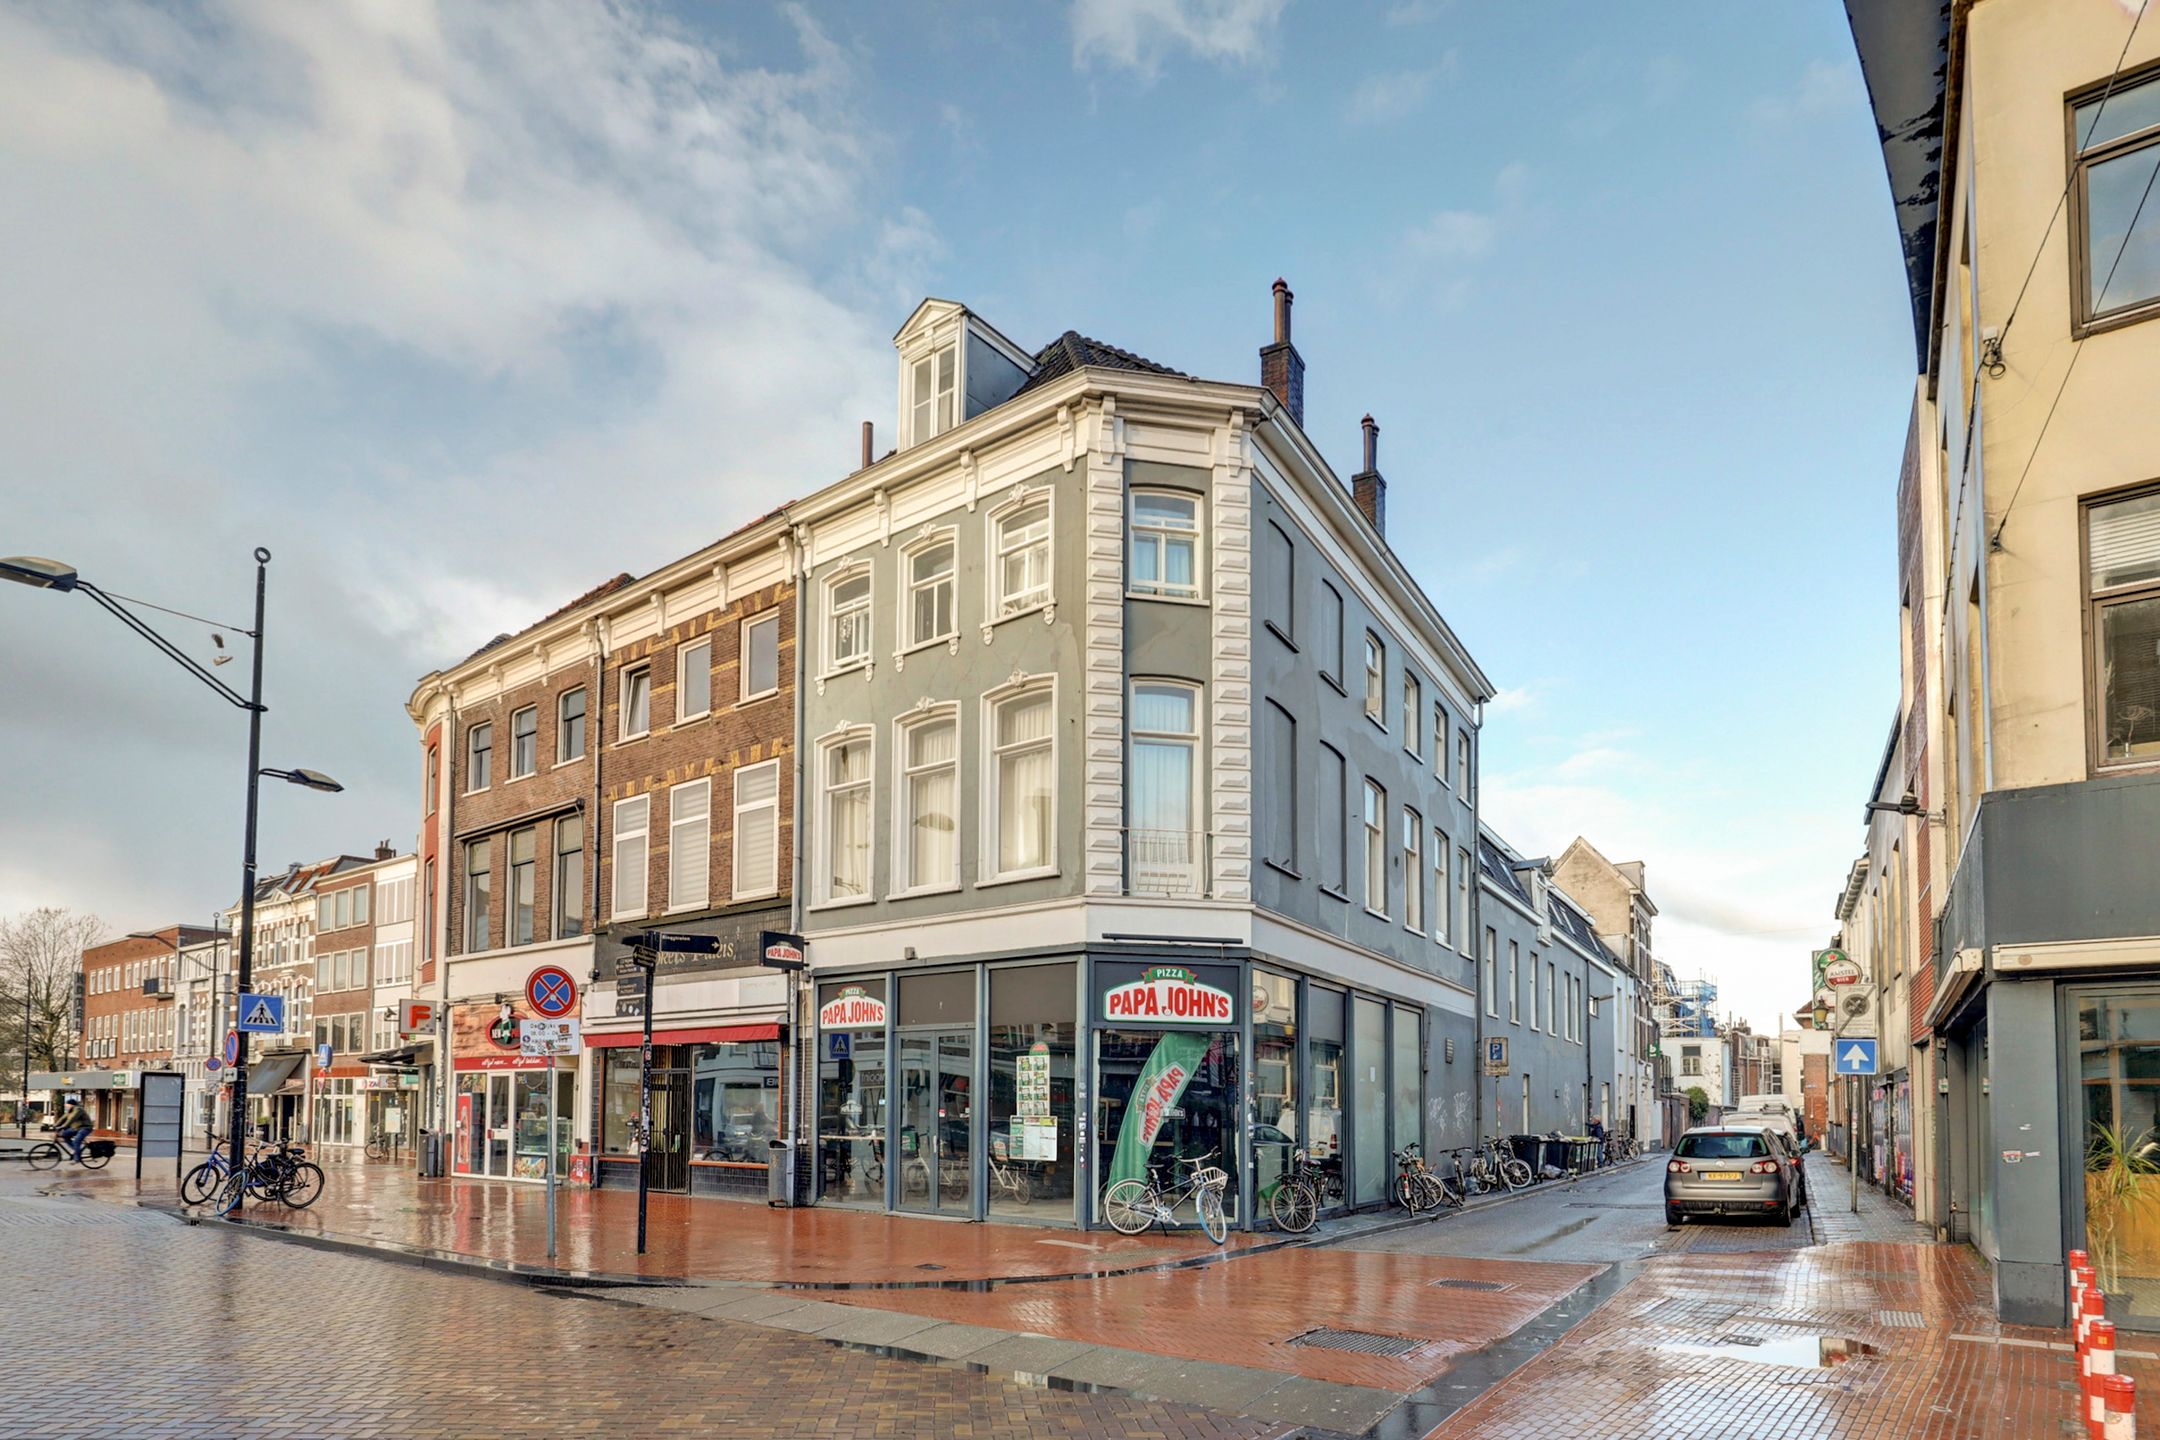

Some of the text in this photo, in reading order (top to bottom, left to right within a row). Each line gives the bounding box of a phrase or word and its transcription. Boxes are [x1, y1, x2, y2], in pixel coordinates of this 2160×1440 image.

[767, 947, 781, 958] PAPA
[1156, 968, 1183, 978] PIZZA
[1830, 969, 1855, 977] AMSTEL
[845, 988, 860, 996] PIZZA
[1109, 986, 1229, 1018] PAPA JOHN'S
[409, 1004, 432, 1028] F
[822, 1001, 884, 1025] PAPA JOHN'S
